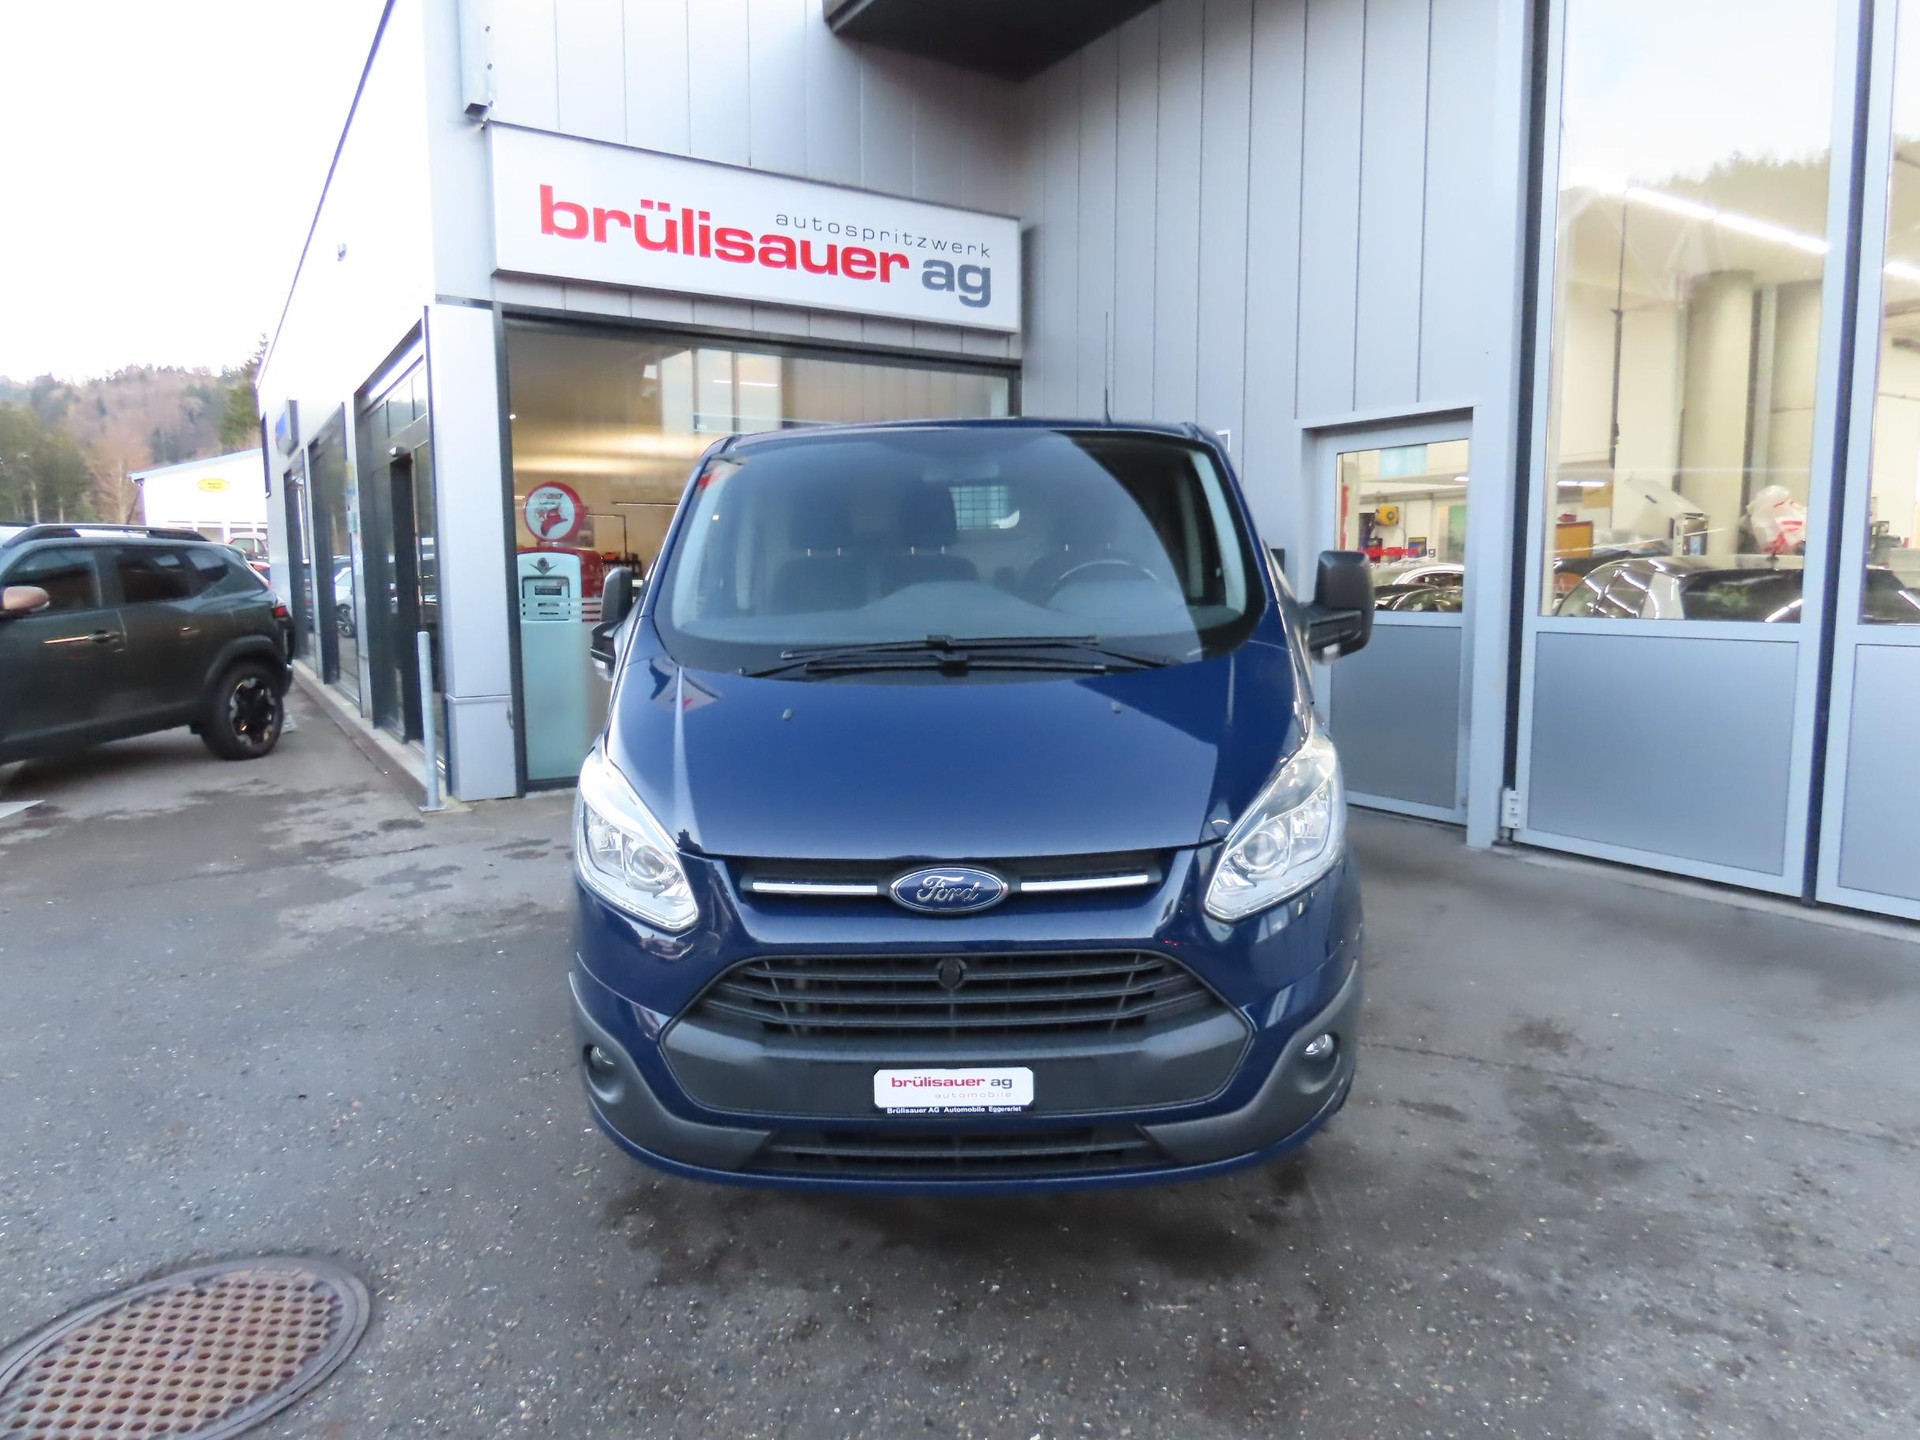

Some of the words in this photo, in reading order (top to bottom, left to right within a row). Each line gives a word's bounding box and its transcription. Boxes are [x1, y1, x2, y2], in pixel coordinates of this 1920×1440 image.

[776, 212, 992, 258] autospritzwerk
[539, 184, 910, 284] brülisauer
[921, 258, 992, 308] ag
[916, 875, 980, 903] Ford
[891, 1076, 986, 1088] brülisauer
[990, 1078, 1013, 1090] ag
[935, 1091, 1013, 1099] automobile
[887, 1107, 927, 1115] Brülisauer
